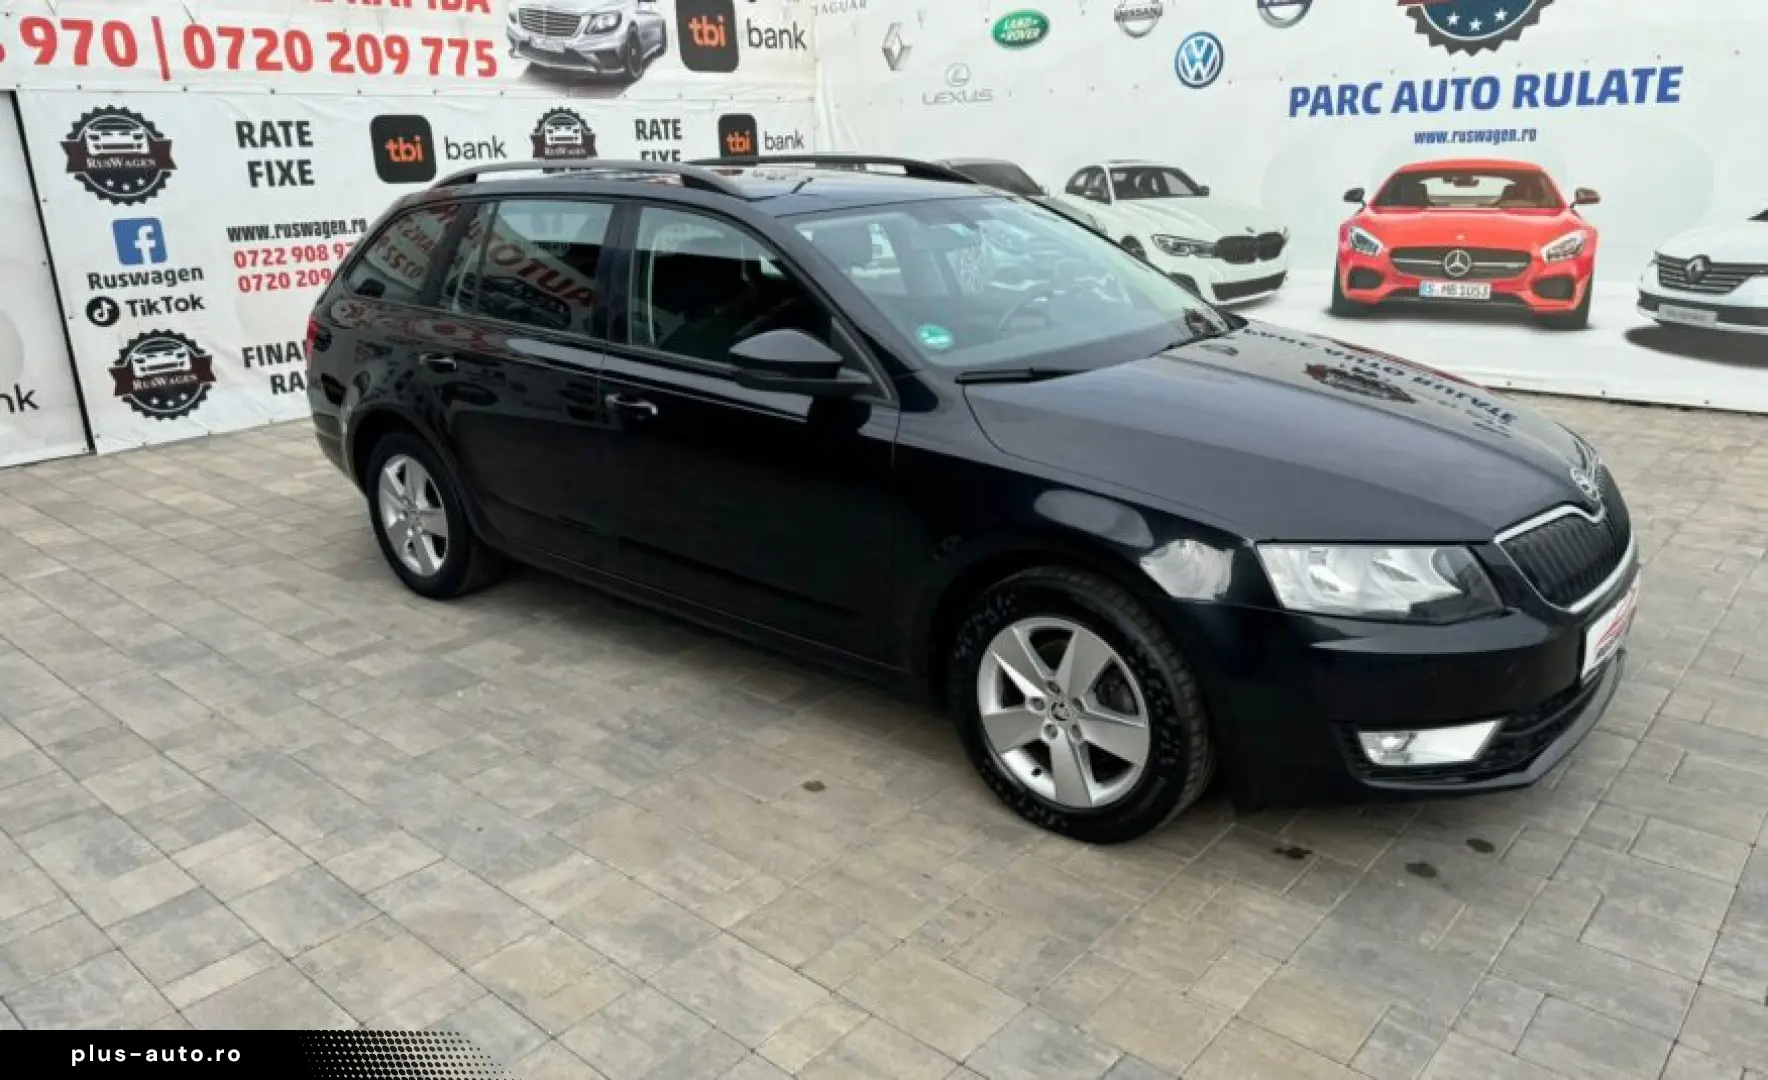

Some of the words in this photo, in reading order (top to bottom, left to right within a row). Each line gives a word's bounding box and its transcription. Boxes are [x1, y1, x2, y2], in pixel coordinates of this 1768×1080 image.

[688, 15, 727, 47] tbi
[746, 17, 807, 50] bank
[19, 15, 138, 67] 970
[183, 22, 314, 73] 0720
[326, 32, 410, 75] 209
[421, 36, 498, 77] 775
[922, 88, 994, 105] LEXUS
[1288, 82, 1383, 117] PARC
[1390, 75, 1500, 113] AUTO
[1512, 66, 1684, 109] RULATE
[235, 120, 314, 148] RATE
[635, 118, 682, 140] RATE
[726, 130, 751, 152] tbi
[764, 129, 804, 151] bank
[1413, 127, 1537, 145] www.ruswagen.ro
[385, 135, 424, 163] tbi
[444, 135, 507, 161] bank
[248, 159, 315, 187] FIXE
[226, 218, 368, 242] www.ruswagen.ro
[233, 248, 288, 269] 0722
[291, 243, 329, 263] 908
[86, 266, 204, 291] Ruswagen
[238, 272, 291, 293] 0720
[124, 293, 205, 318] TikTok
[241, 340, 307, 368] FINA
[270, 370, 307, 395] RA
